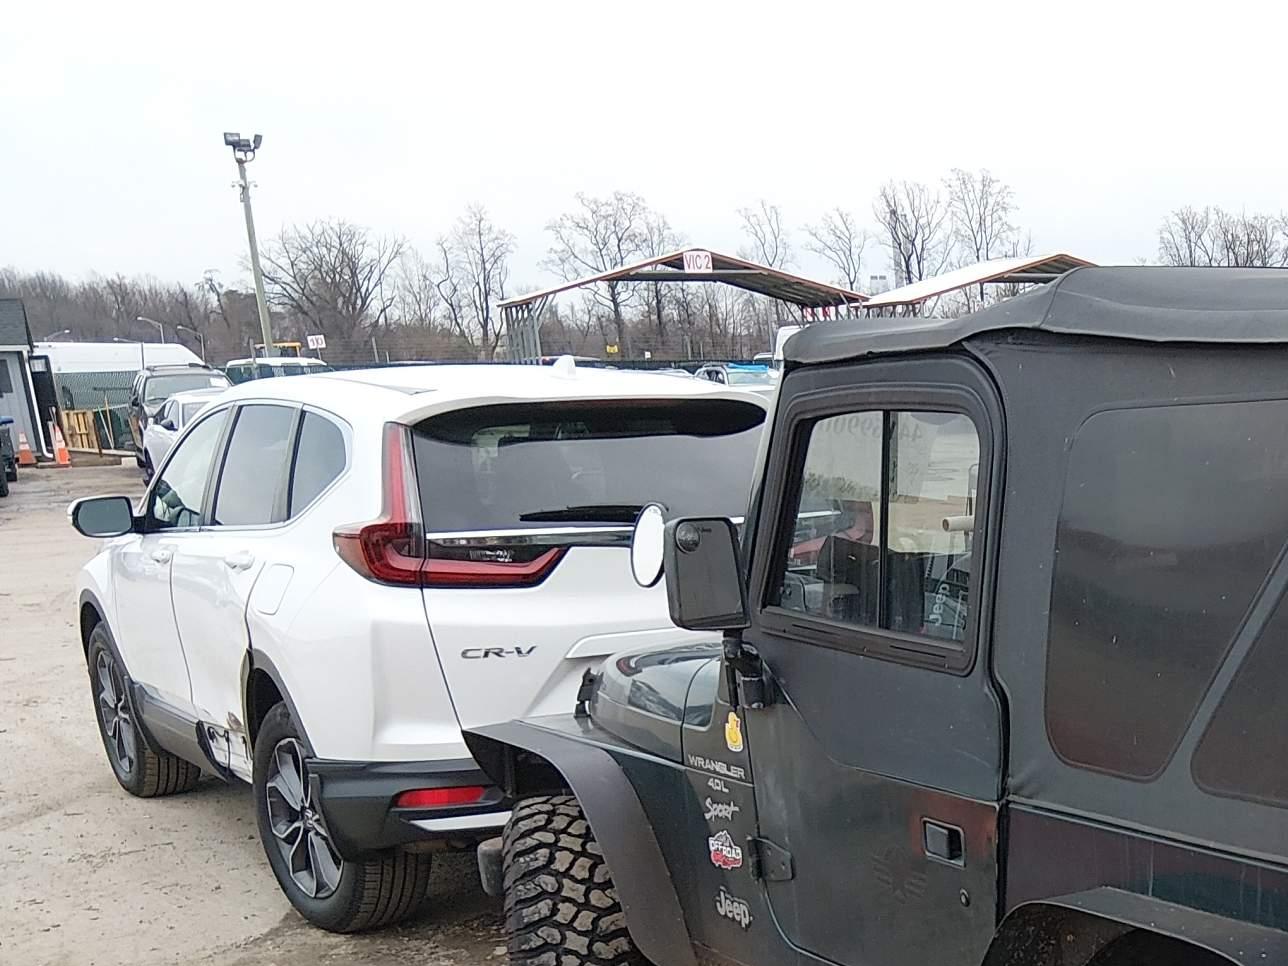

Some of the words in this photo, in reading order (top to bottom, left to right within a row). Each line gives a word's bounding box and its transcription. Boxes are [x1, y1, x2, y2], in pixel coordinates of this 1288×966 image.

[684, 254, 702, 270] VIC
[704, 254, 711, 270] 2
[929, 583, 950, 626] Jeep
[461, 645, 537, 659] CR-V
[688, 754, 745, 779] WRANGLER
[704, 797, 740, 821] Sport
[715, 889, 751, 928] Jeep
